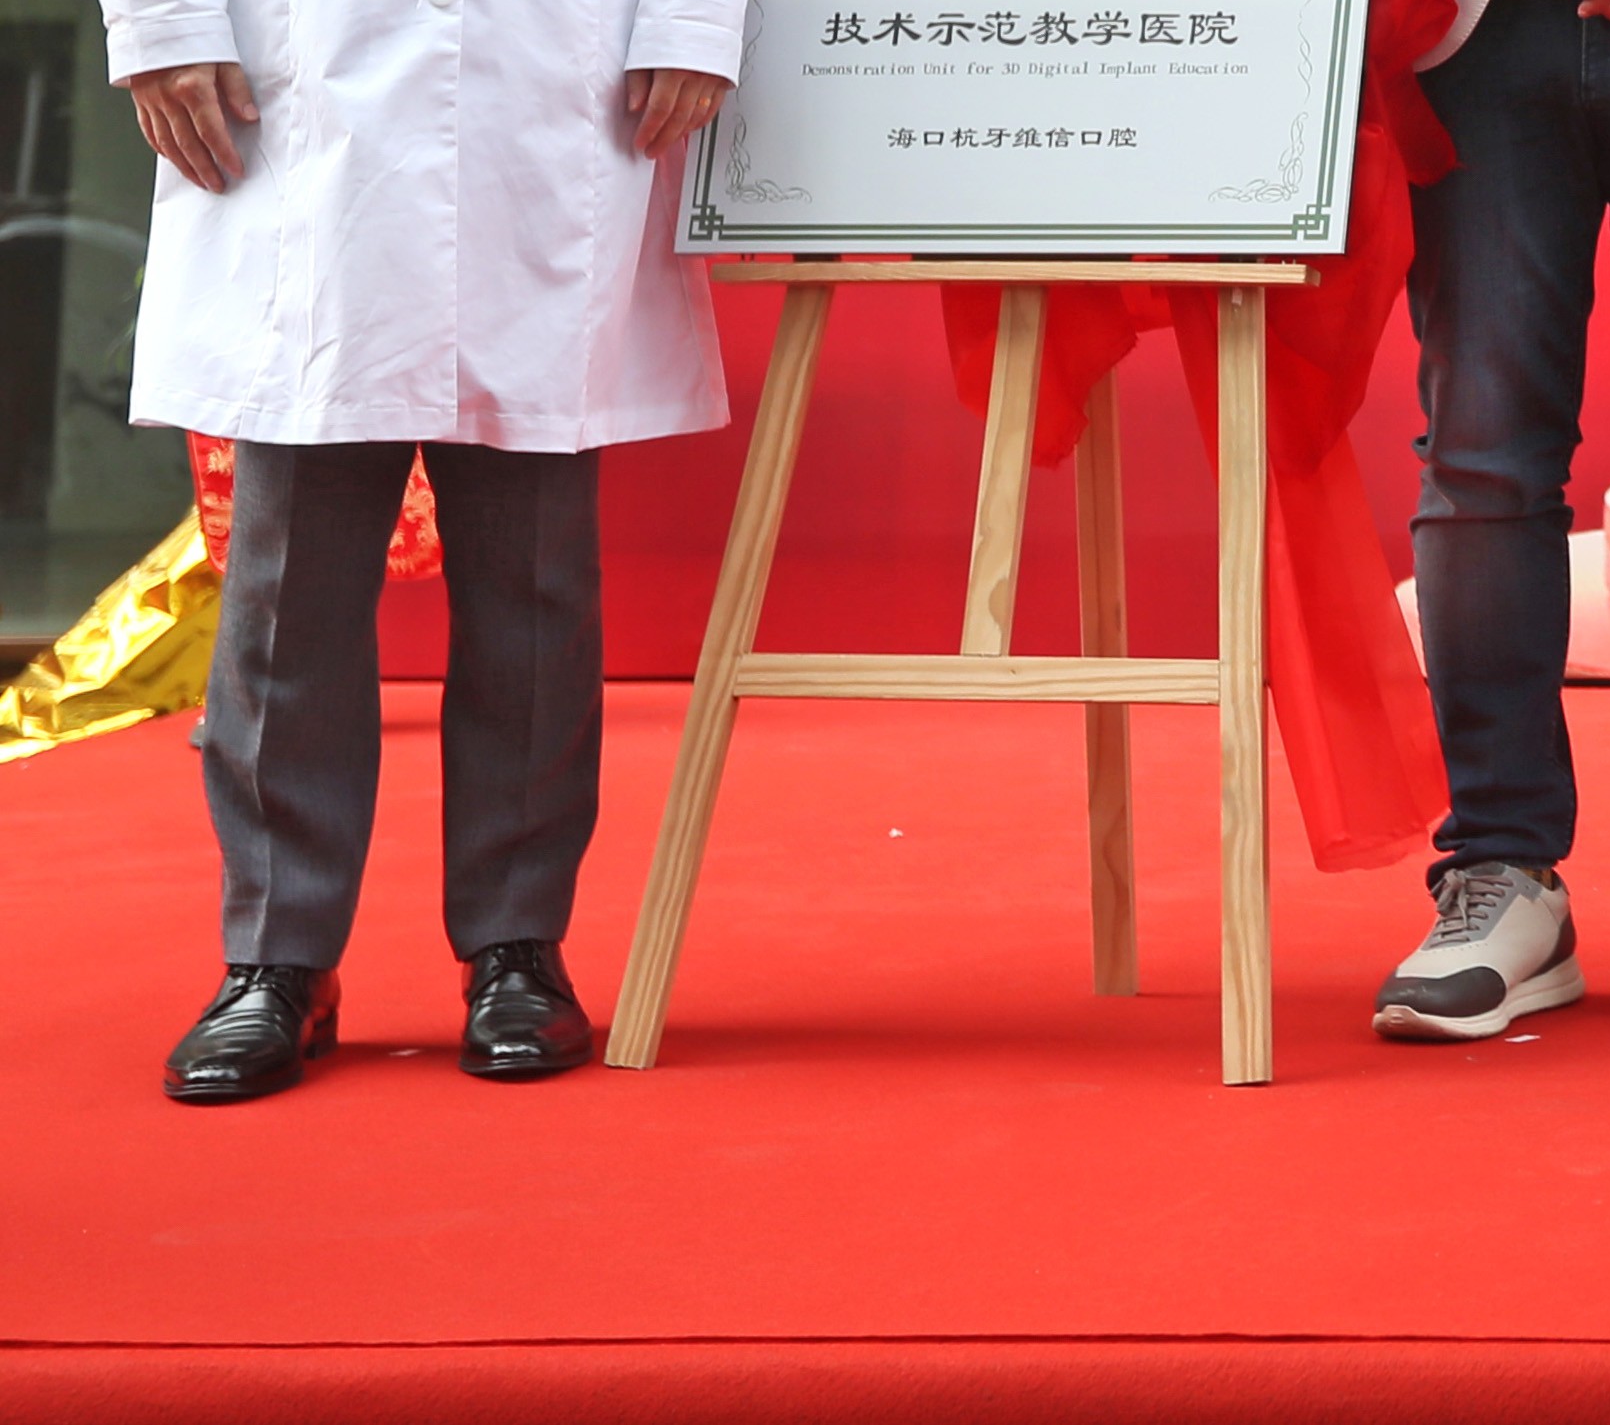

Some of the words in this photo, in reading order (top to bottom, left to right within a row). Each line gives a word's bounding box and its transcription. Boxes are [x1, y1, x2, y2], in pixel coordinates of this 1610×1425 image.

[821, 11, 1239, 47] 技术示范教学医院
[801, 63, 915, 76] Demonstration
[923, 62, 956, 75] Unit
[967, 62, 994, 75] for
[1002, 62, 1021, 75] 3D
[1028, 62, 1089, 78] Digital
[1099, 62, 1158, 78] Implant
[1169, 62, 1250, 75] Education
[887, 128, 1138, 149] 海口杭牙维信口腔
